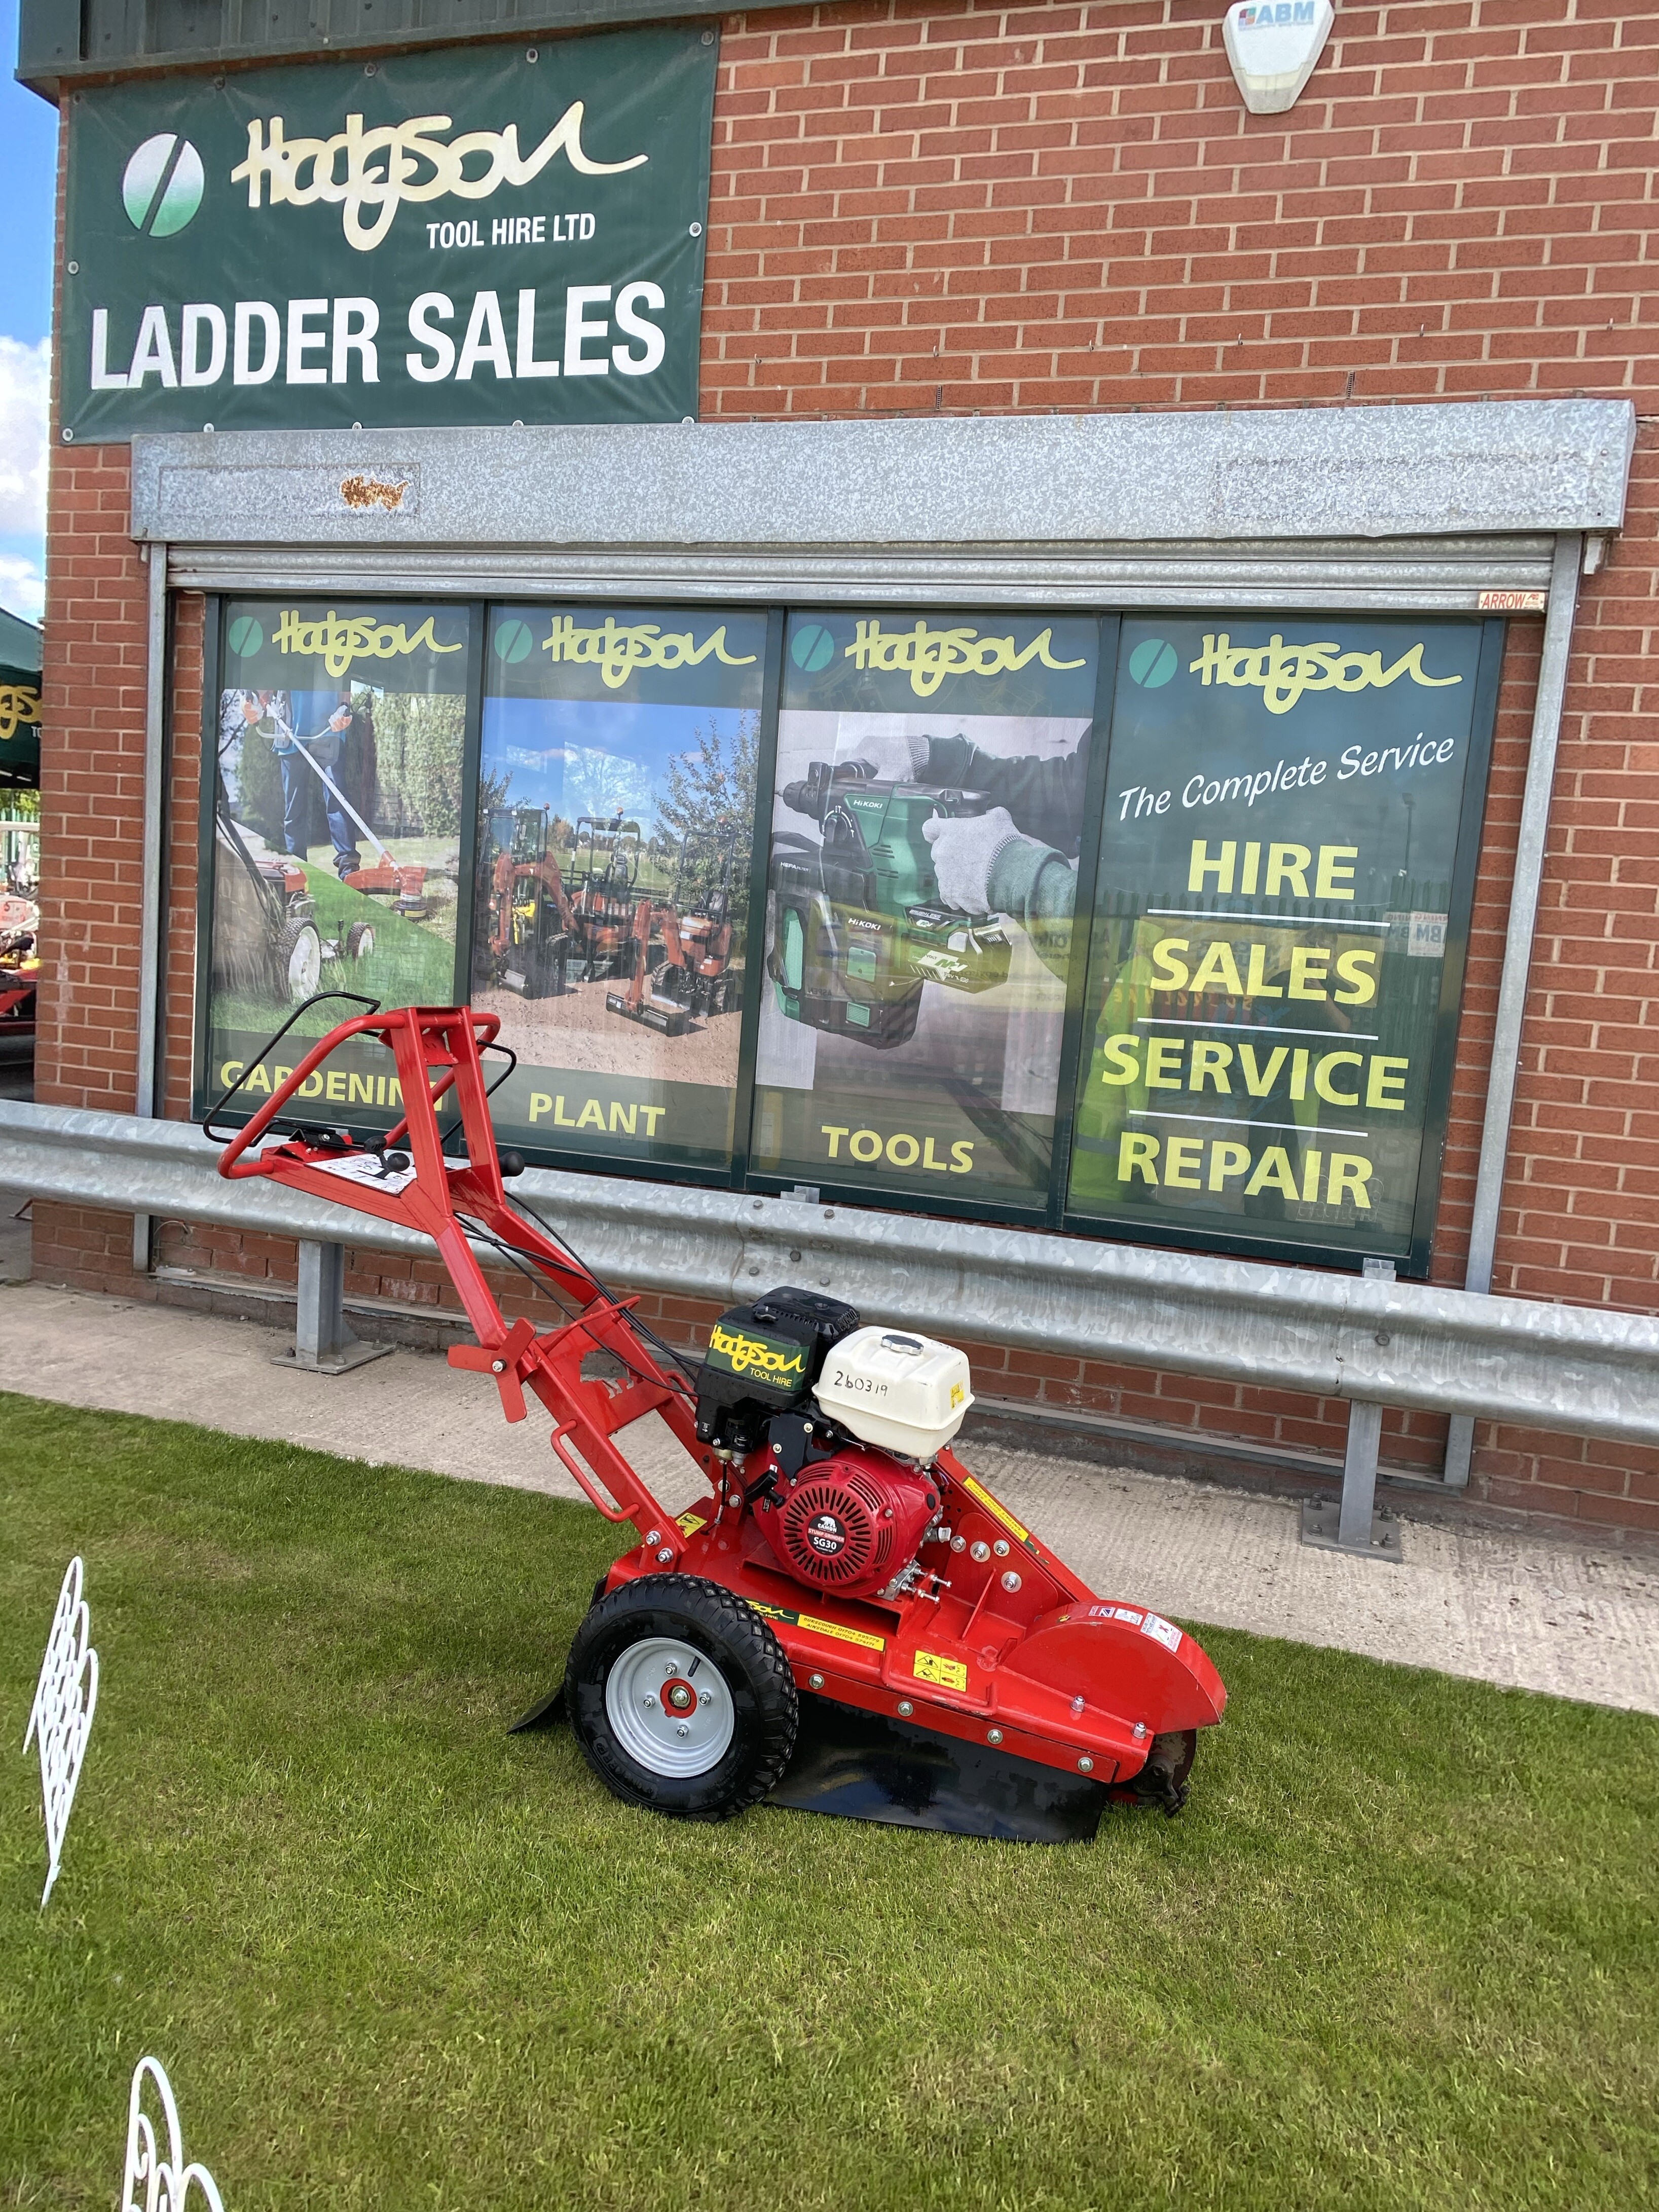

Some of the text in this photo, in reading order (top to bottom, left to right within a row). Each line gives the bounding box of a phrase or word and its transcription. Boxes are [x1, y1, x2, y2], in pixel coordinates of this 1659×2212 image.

[1255, 1, 1315, 24] ABM
[231, 101, 649, 251] Hodgson
[426, 213, 596, 249] TOOL HIRE LTD
[91, 281, 666, 390] LADDER SALES
[1482, 593, 1526, 609] ARROW
[271, 610, 463, 678] Hodgson
[542, 615, 758, 689] Hodgson
[844, 620, 1086, 697] Hodgson
[1189, 633, 1463, 715] Hodgson
[1119, 732, 1455, 821] The Complete Service
[1187, 839, 1359, 900] HIRE
[1150, 938, 1377, 1005] SALES
[220, 1060, 443, 1111] GARDENIN
[1100, 1034, 1410, 1111] SERVICE
[528, 1092, 666, 1137] PLANT
[821, 1125, 974, 1173] TOOLS
[1117, 1131, 1374, 1209] REPAIR
[709, 1324, 806, 1373] Hodgson
[750, 1367, 792, 1387] TOOL HIRE
[807, 1528, 845, 1543] STUMP GRINDER
[813, 1536, 837, 1550] SG30
[817, 1523, 837, 1533] CAMON
[803, 1617, 837, 1630] BURSCOUGH
[838, 1627, 856, 1636] 01704
[806, 1623, 834, 1635] AINSDALE
[835, 1631, 853, 1640] 01704
